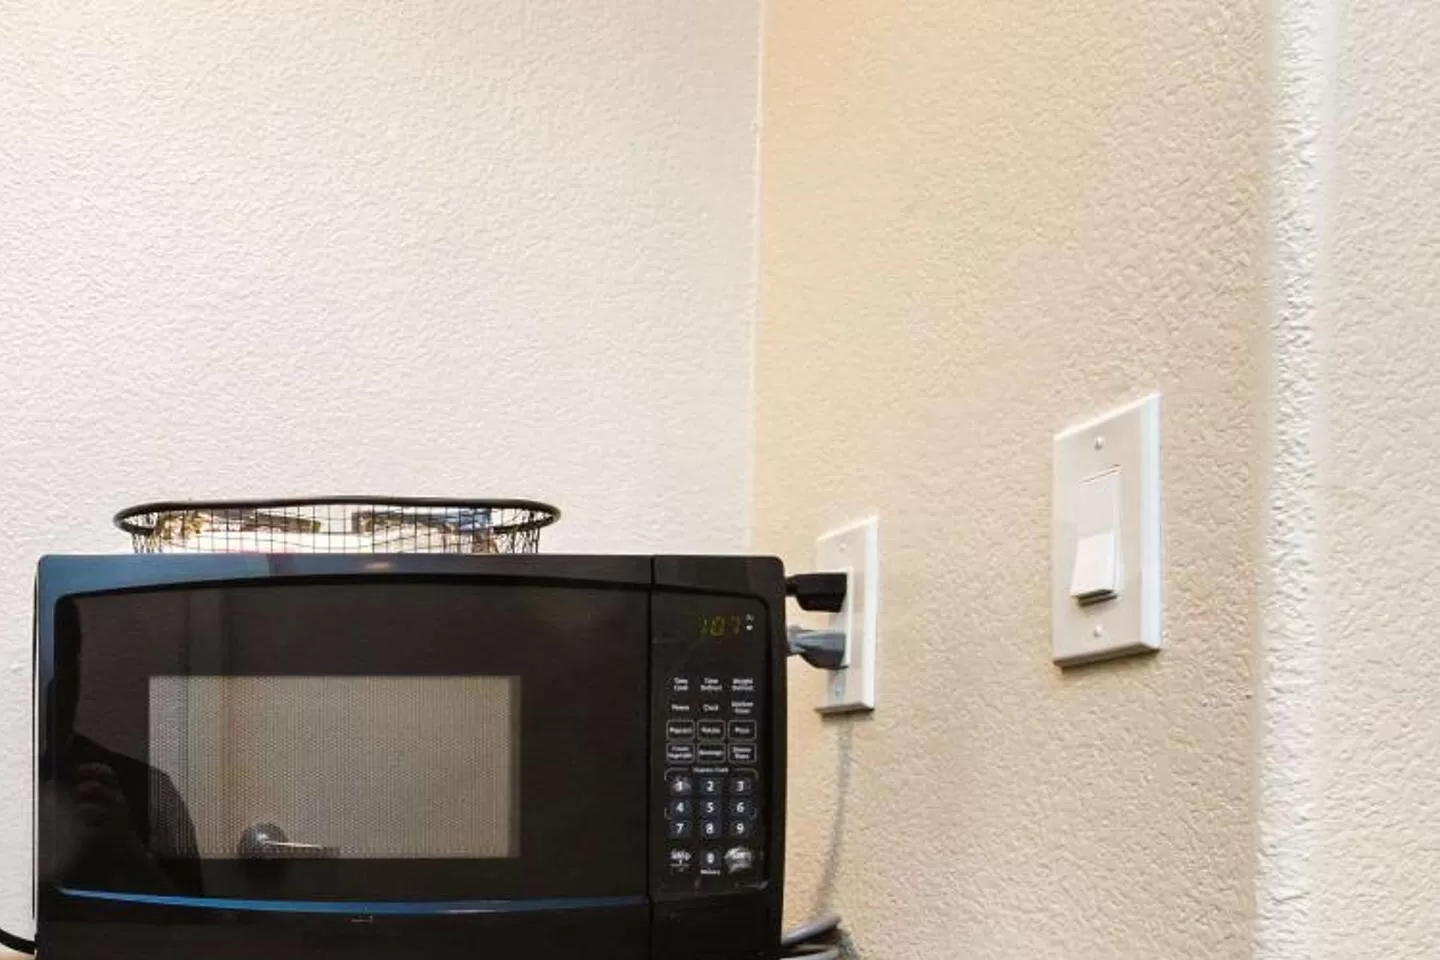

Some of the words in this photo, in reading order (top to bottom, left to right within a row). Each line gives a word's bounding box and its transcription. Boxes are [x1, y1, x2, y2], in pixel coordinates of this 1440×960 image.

[706, 780, 714, 792] 2
[736, 780, 744, 792] 3
[676, 802, 685, 813] 4
[706, 801, 714, 813] 5
[736, 801, 745, 813] 6
[676, 823, 684, 834] 7
[706, 822, 714, 834] 8
[736, 822, 744, 835] 9
[706, 852, 715, 864] 0
